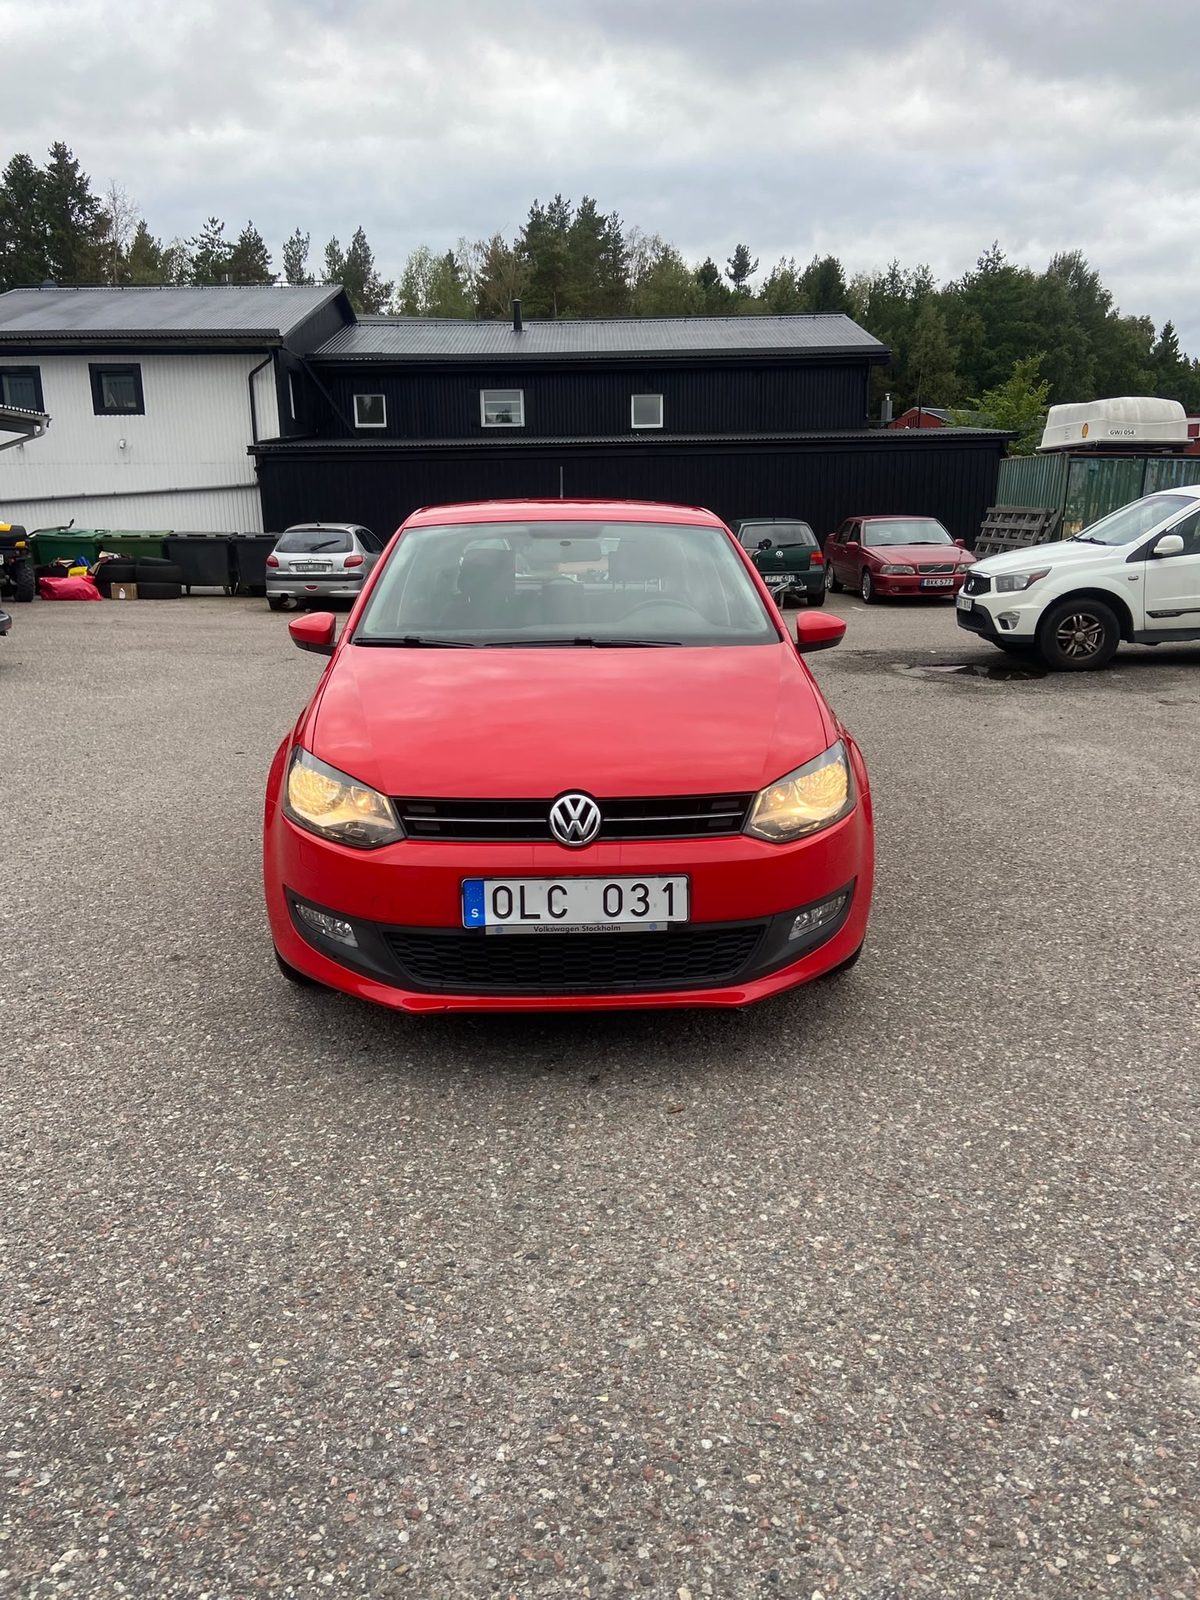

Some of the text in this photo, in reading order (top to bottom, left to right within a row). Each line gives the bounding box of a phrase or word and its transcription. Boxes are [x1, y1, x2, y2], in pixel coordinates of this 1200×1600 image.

[471, 882, 674, 920] S OLC 031
[533, 924, 621, 934] Volkswagen Stockholm
